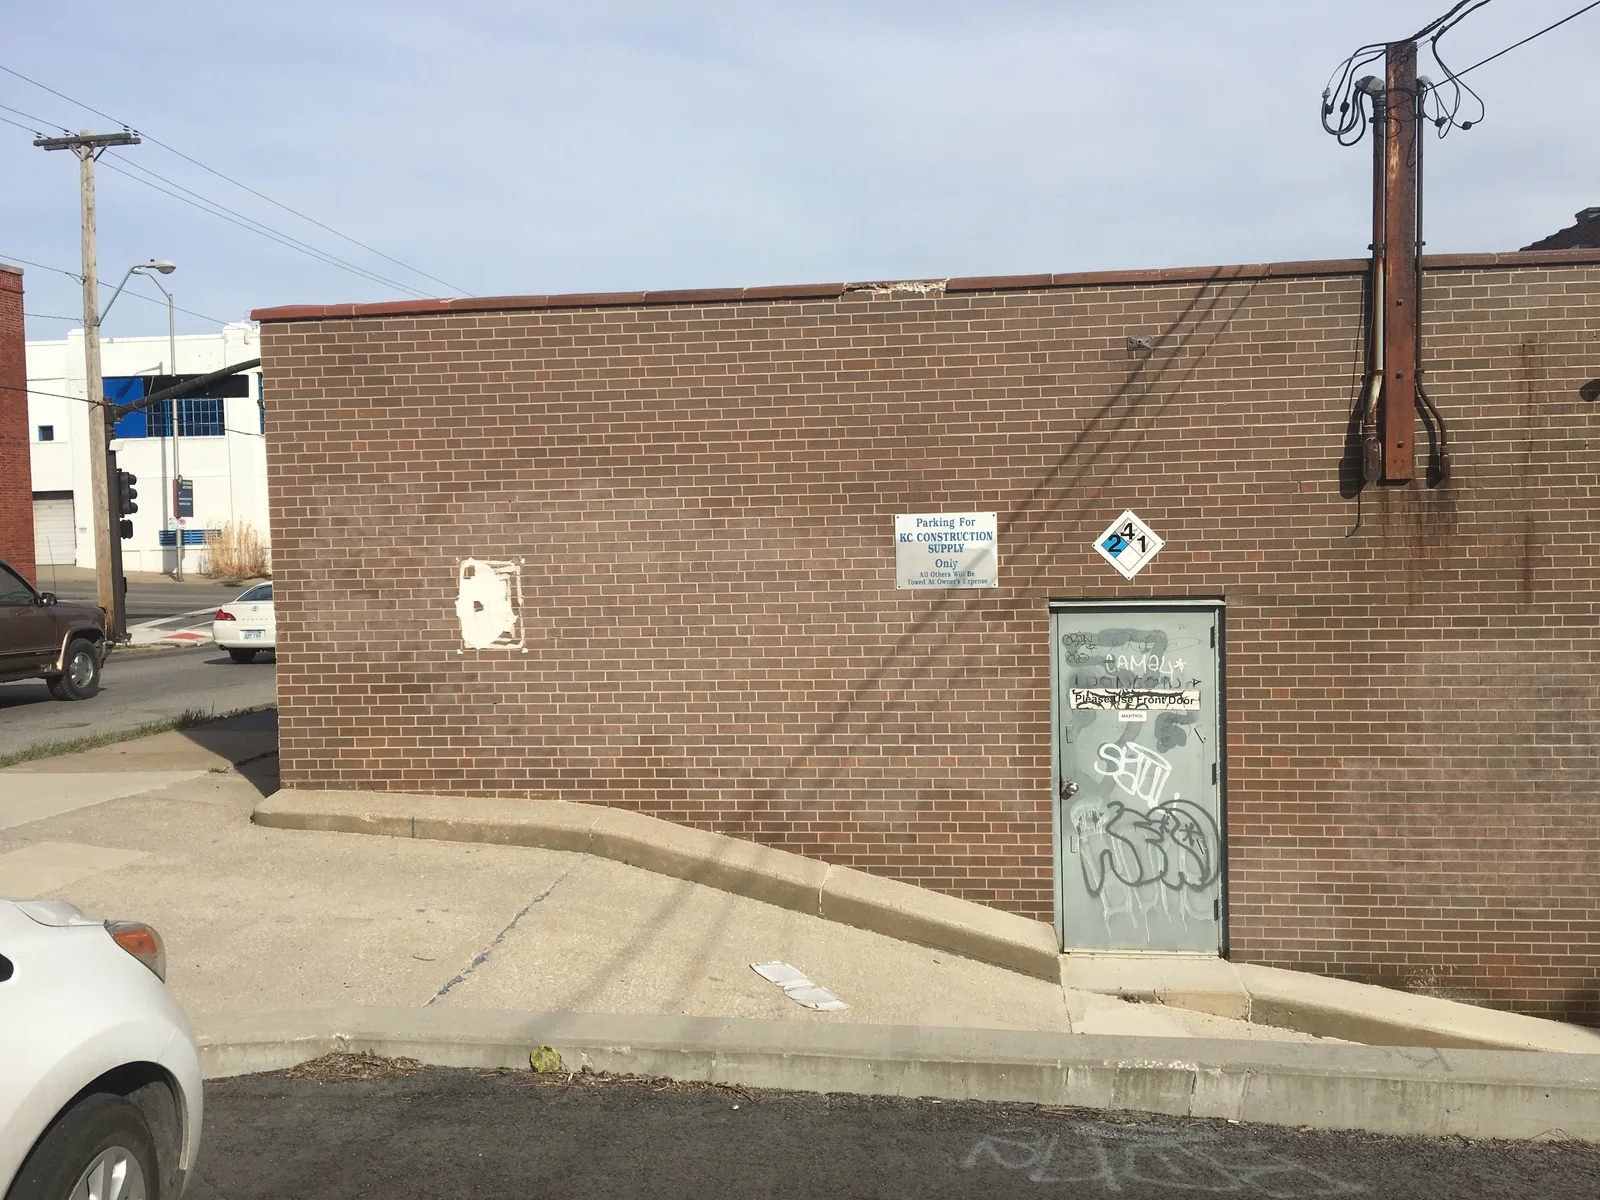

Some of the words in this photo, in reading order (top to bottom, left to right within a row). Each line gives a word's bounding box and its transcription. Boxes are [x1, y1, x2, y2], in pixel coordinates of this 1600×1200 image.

[916, 517, 955, 529] Parking
[959, 517, 976, 527] For
[899, 533, 913, 542] KC
[916, 531, 993, 542] CONSTRUCTION
[1120, 522, 1135, 540] 4
[928, 543, 965, 553] SUPPLY
[1107, 534, 1122, 552] 2
[1136, 535, 1146, 552] 1
[935, 558, 958, 570] Only
[927, 578, 935, 586] At
[936, 578, 961, 586] Owner's
[962, 578, 988, 586] Expense
[1075, 694, 1110, 704] Please
[1136, 694, 1166, 705] Front
[1168, 695, 1195, 705] Door
